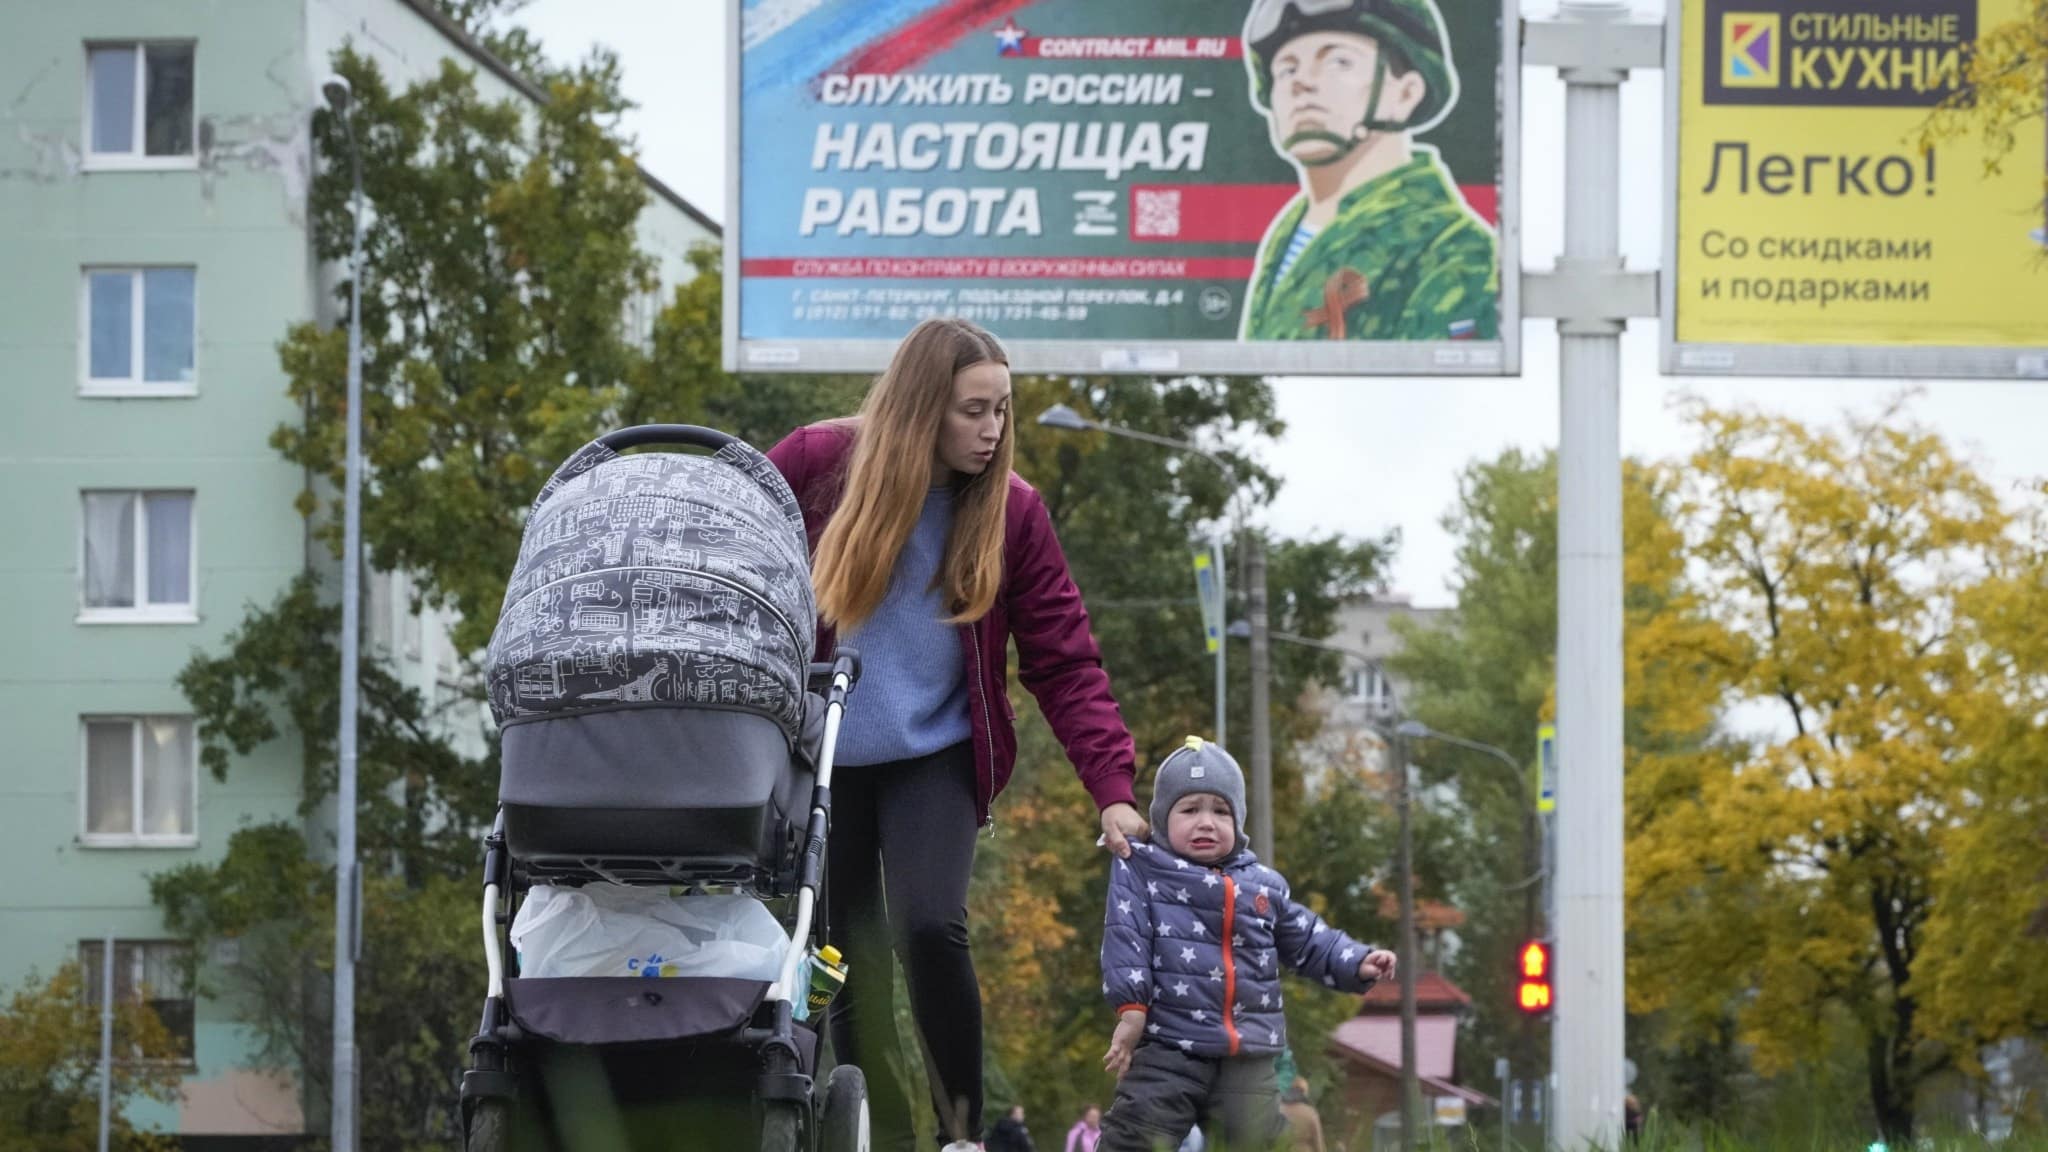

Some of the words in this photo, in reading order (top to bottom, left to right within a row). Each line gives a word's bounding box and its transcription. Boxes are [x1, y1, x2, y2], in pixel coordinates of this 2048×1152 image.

[1790, 13, 1959, 42] СТИЛЬНЫЕ
[1039, 38, 1226, 57] CONTRACT.MIL.RU
[1790, 47, 1960, 90] КУХНИ
[822, 74, 1012, 104] СЛУЖИТЬ
[1024, 74, 1182, 104] РОССИИ
[811, 122, 1209, 179] НАСТОЯЩАЯ
[1702, 142, 1936, 196] Легко!
[801, 187, 1043, 237] РАБОТА
[1701, 230, 1749, 259] Со
[1758, 238, 1932, 262] скидками
[792, 260, 863, 276] СЛУЖБА
[866, 260, 889, 276] ПО
[892, 260, 984, 276] КОНТРАКТУ
[988, 260, 999, 276] В
[1129, 260, 1186, 276] СИЛАХ
[1701, 279, 1720, 300] и
[1731, 277, 1931, 308] подарками
